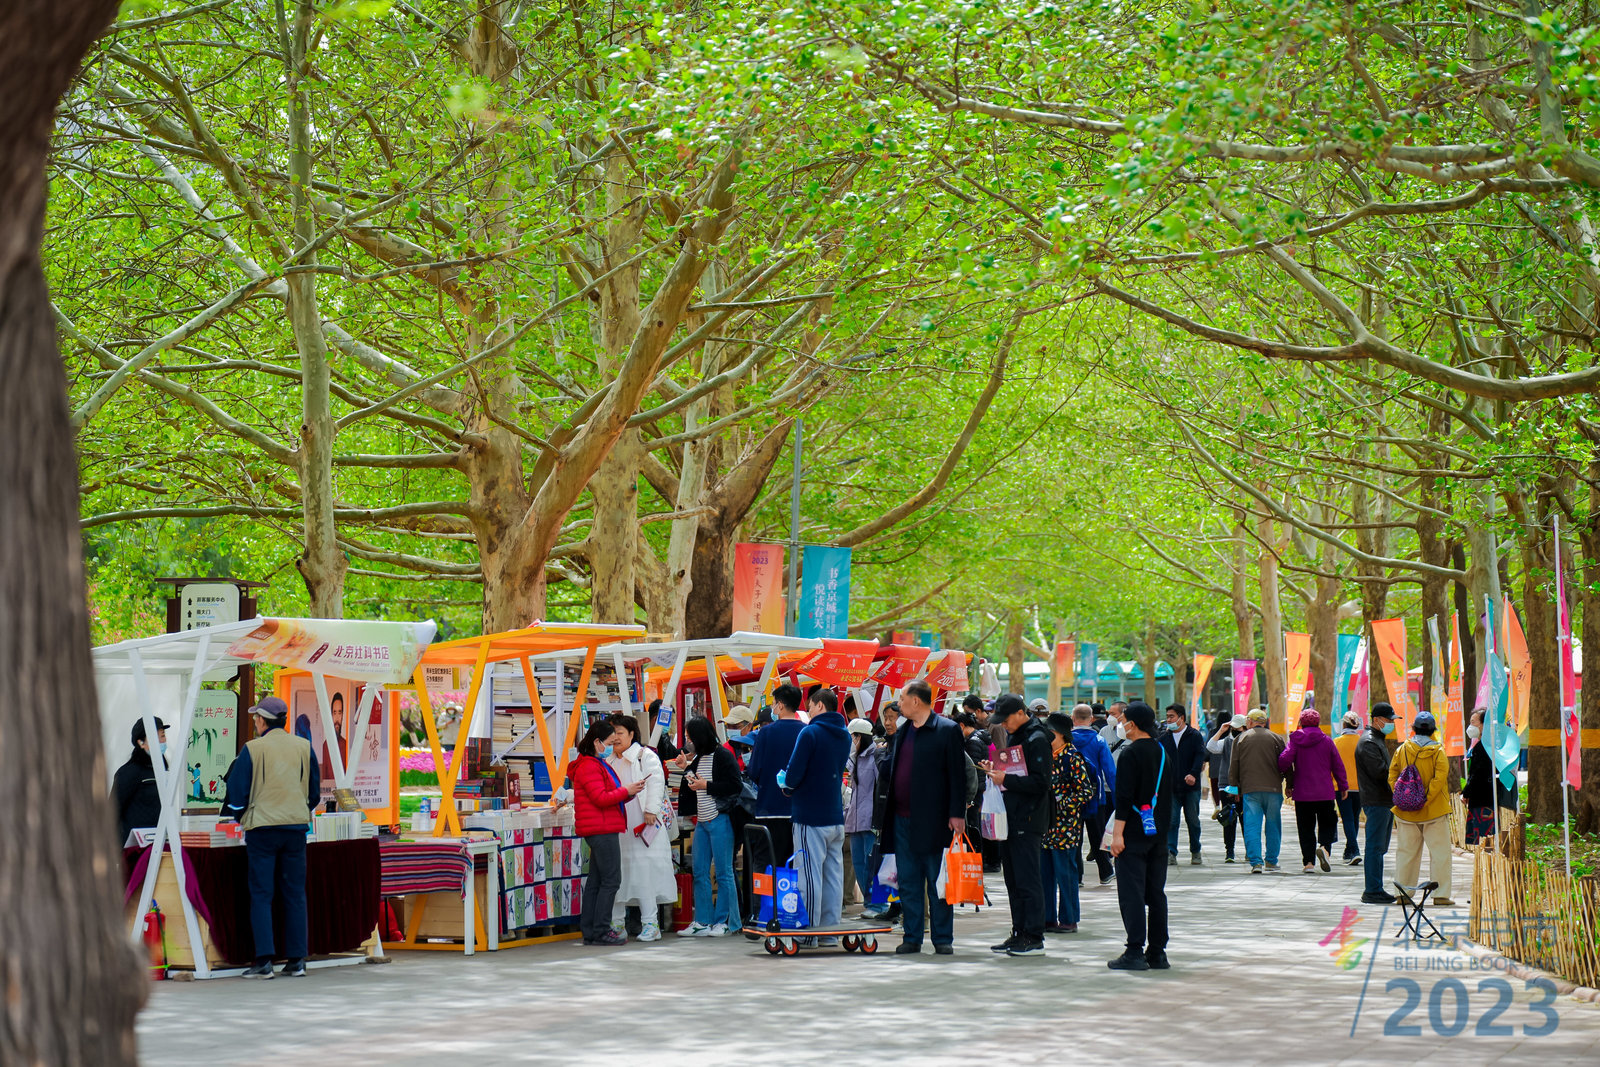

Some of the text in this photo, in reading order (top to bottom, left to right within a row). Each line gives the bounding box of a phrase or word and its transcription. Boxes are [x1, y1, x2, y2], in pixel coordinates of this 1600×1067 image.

[751, 557, 769, 565] 2023
[825, 567, 840, 614] 书香京城
[813, 583, 826, 630] 悦读春天
[333, 645, 390, 660] 北京社科书店
[937, 675, 954, 687] 2023
[1447, 700, 1463, 712] 202
[204, 707, 234, 719] 共产党
